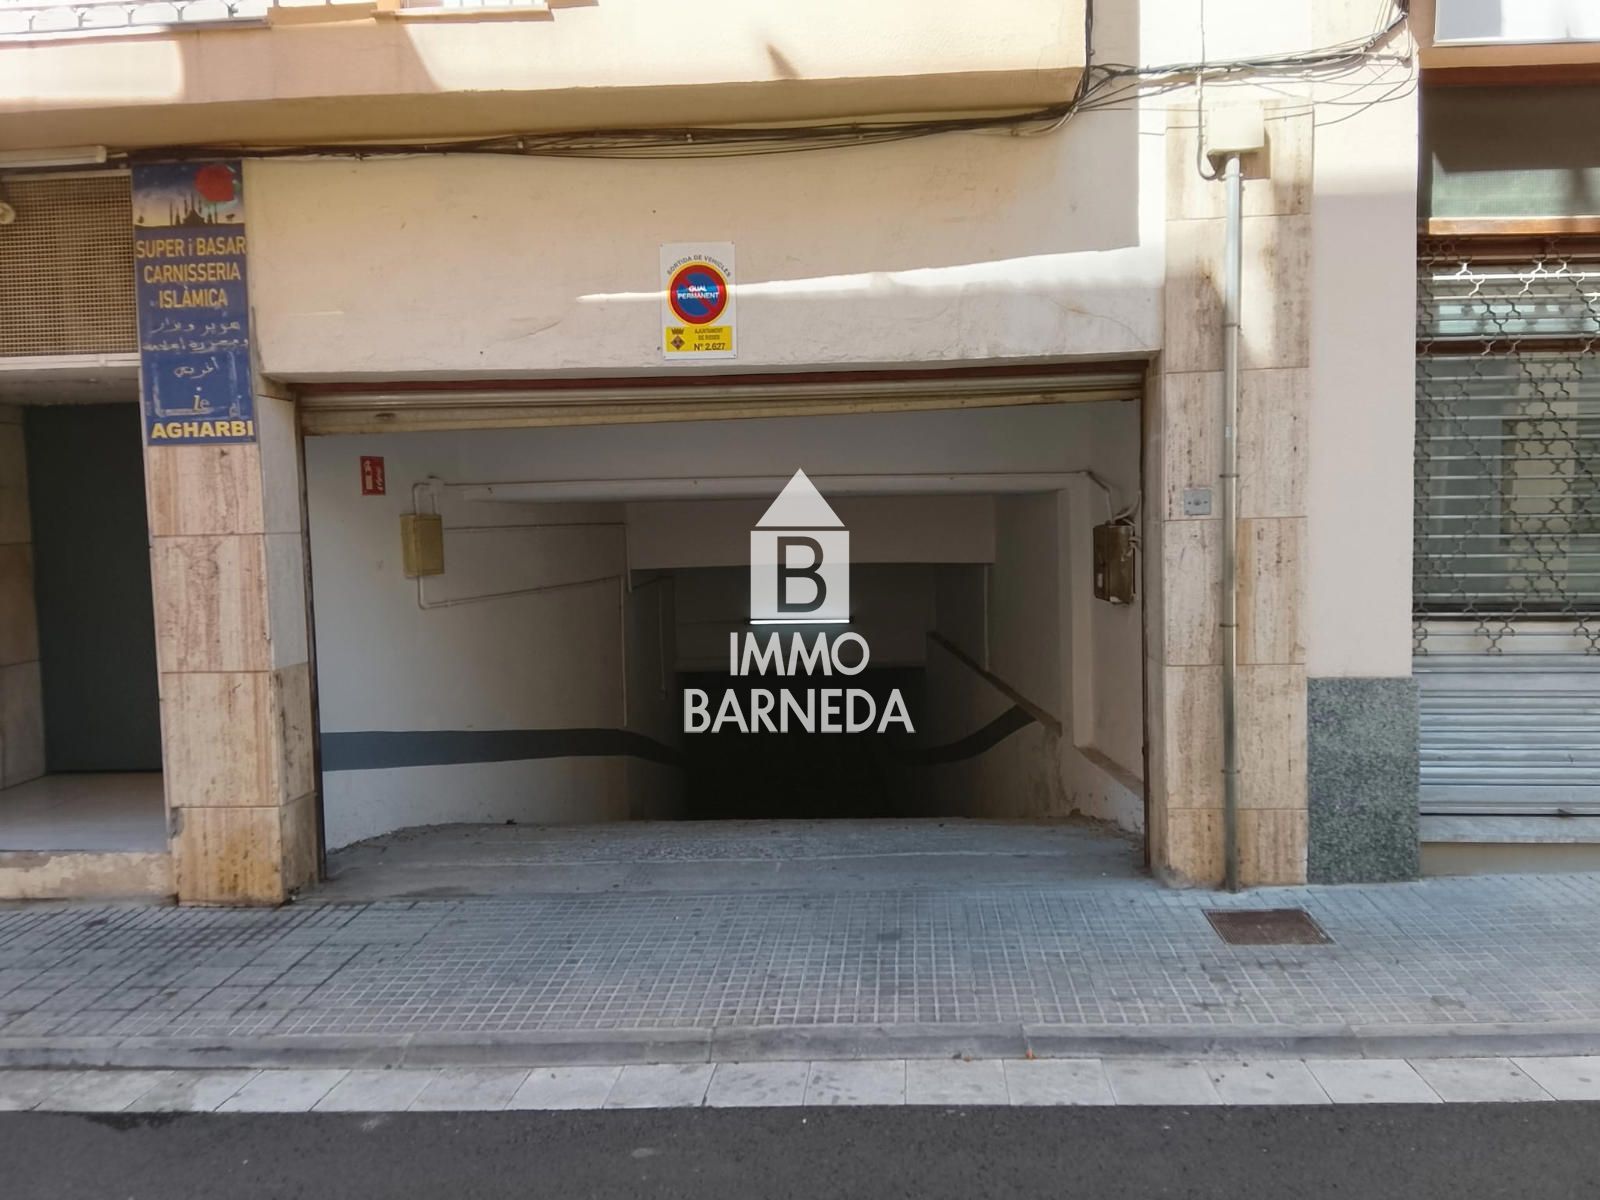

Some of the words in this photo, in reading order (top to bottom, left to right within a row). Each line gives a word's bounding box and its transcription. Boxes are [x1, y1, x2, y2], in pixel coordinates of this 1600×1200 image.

[135, 239, 185, 258] SUPER
[188, 238, 193, 256] i
[196, 236, 246, 256] BASAR
[144, 262, 241, 283] CARNISSERIA
[667, 256, 692, 275] SORTIDA
[704, 256, 731, 277] VEHICLES
[159, 285, 228, 308] ISLÀMICA
[677, 292, 720, 300] PERMANENT
[705, 342, 726, 351] 2.627
[151, 420, 255, 438] AGHARBI
